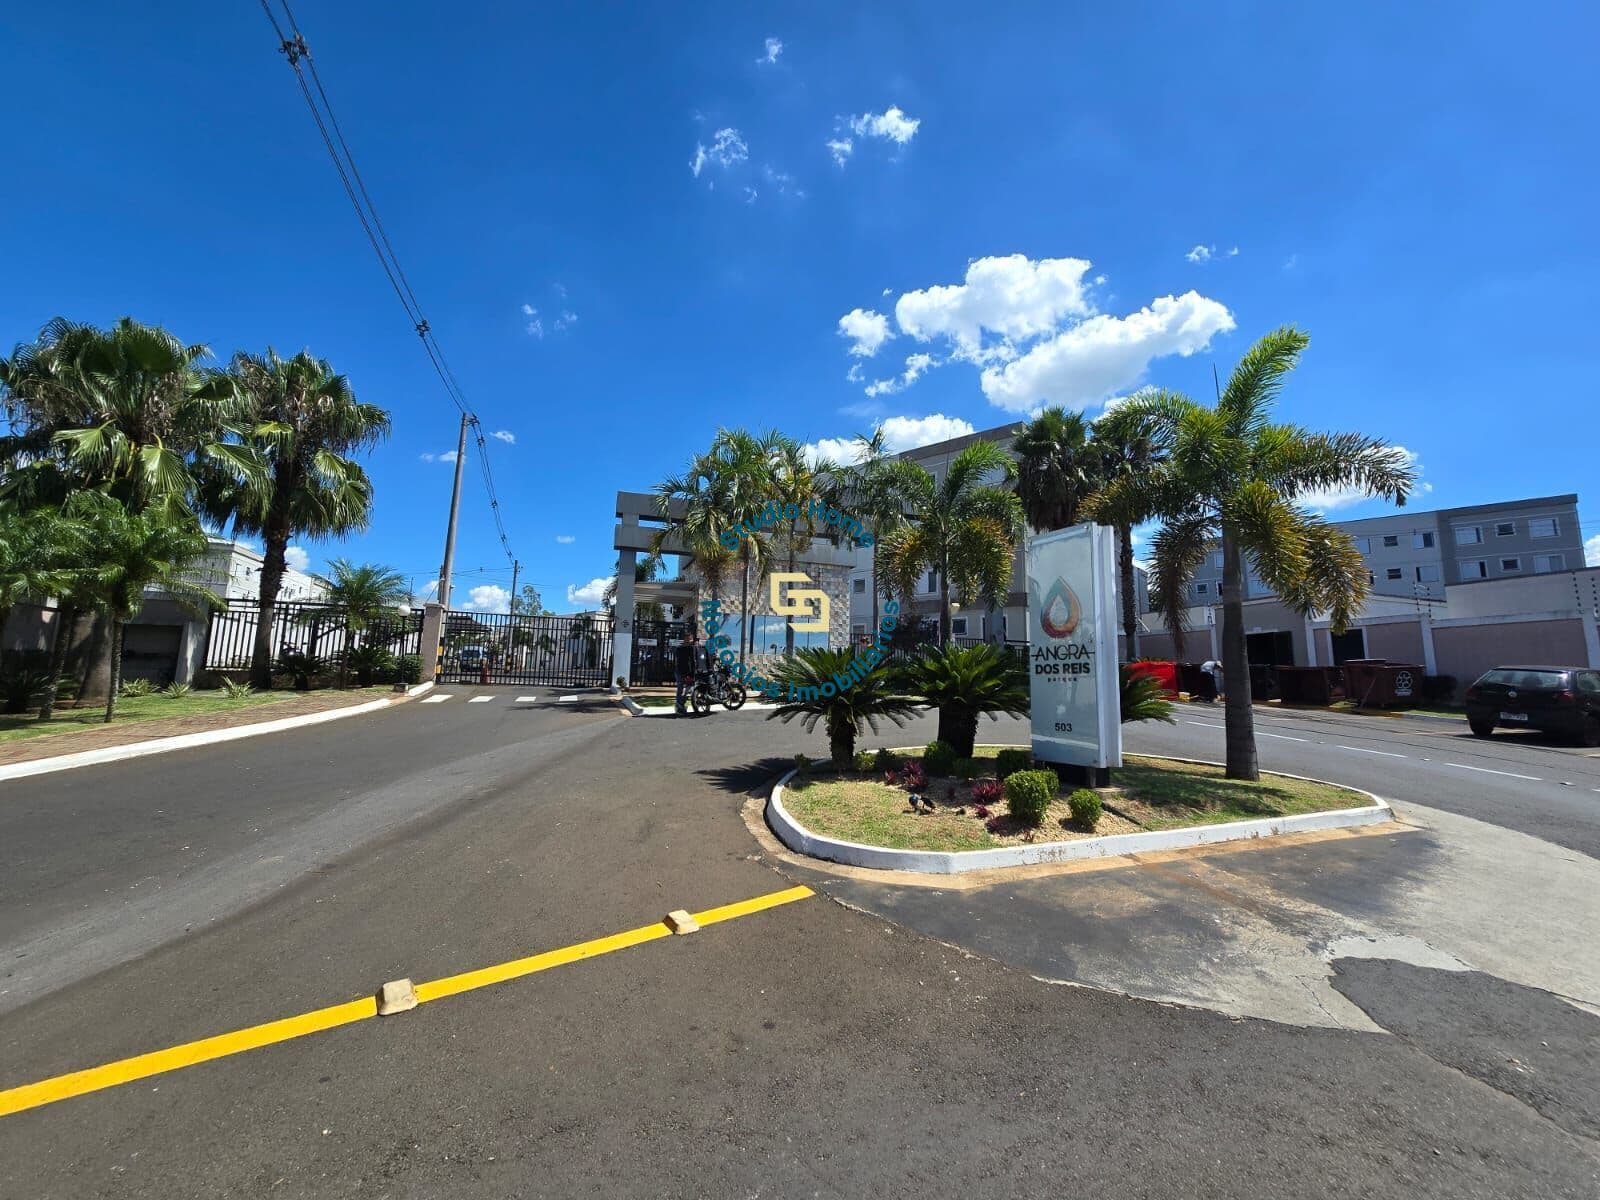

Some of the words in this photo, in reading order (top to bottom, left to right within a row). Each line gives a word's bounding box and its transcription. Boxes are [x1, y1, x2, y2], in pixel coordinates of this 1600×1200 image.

[1034, 643, 1091, 661] ANGRA
[1035, 663, 1060, 675] DOS
[1062, 662, 1091, 675] REIS
[1055, 722, 1073, 733] 503
